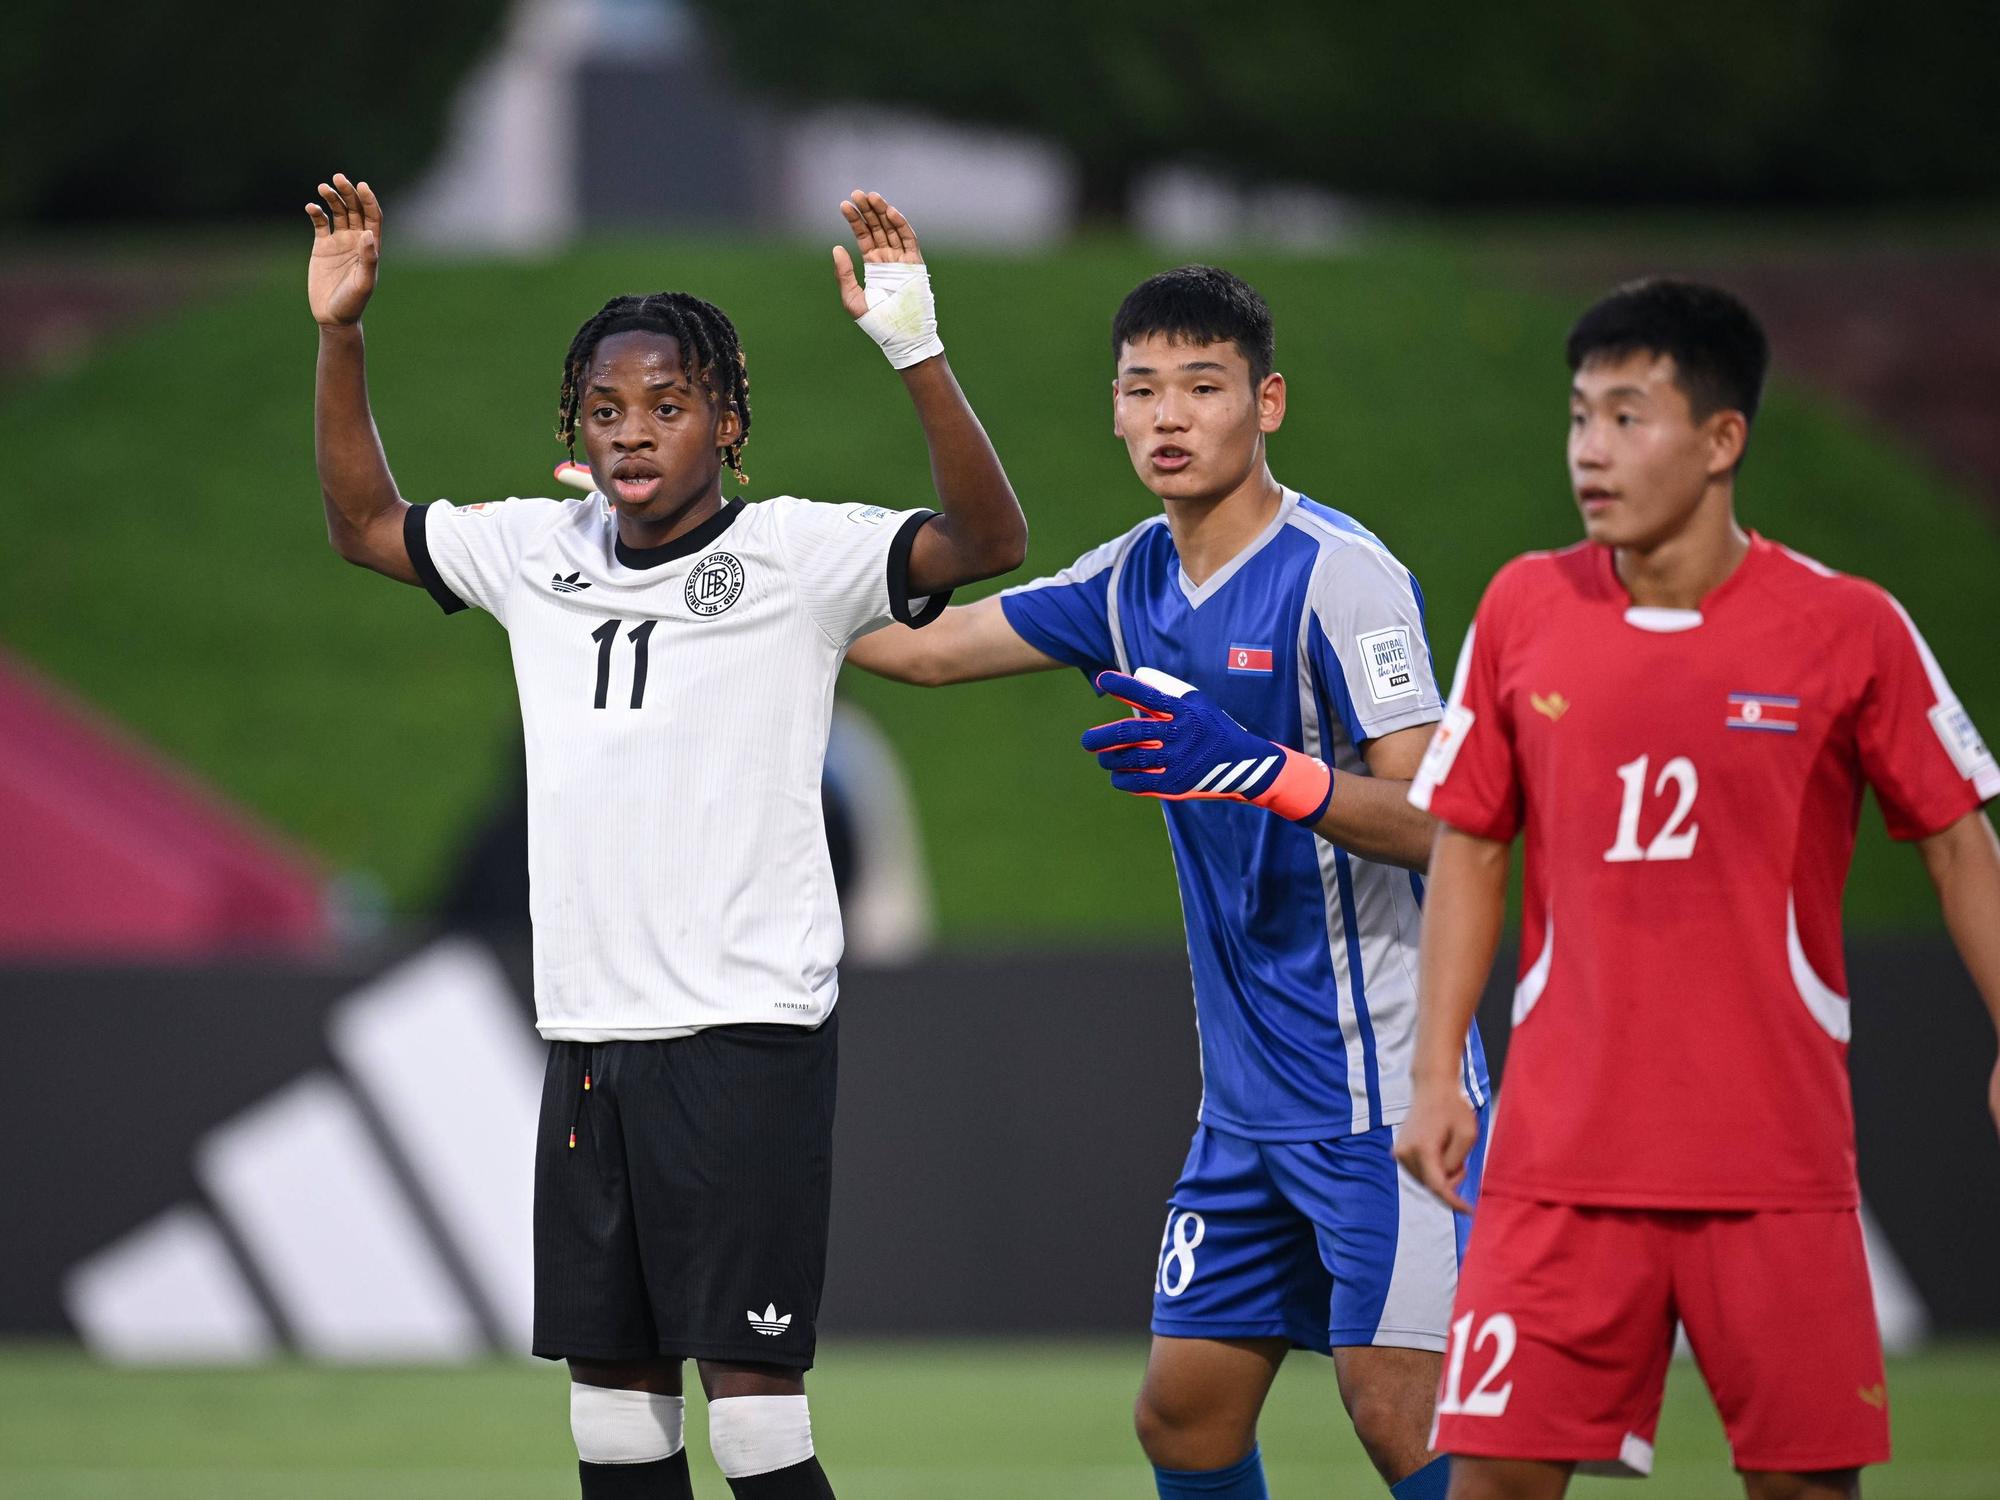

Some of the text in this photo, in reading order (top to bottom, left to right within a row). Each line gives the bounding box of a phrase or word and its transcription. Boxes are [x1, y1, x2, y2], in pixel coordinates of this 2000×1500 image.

[687, 562, 706, 610] DEUTSCHER
[590, 619, 658, 709] 11
[1372, 638, 1404, 653] FOOTBAL
[1377, 665, 1391, 678] the
[1391, 676, 1408, 685] FIFA
[1603, 753, 1699, 862] 12
[1438, 1309, 1517, 1417] 12
